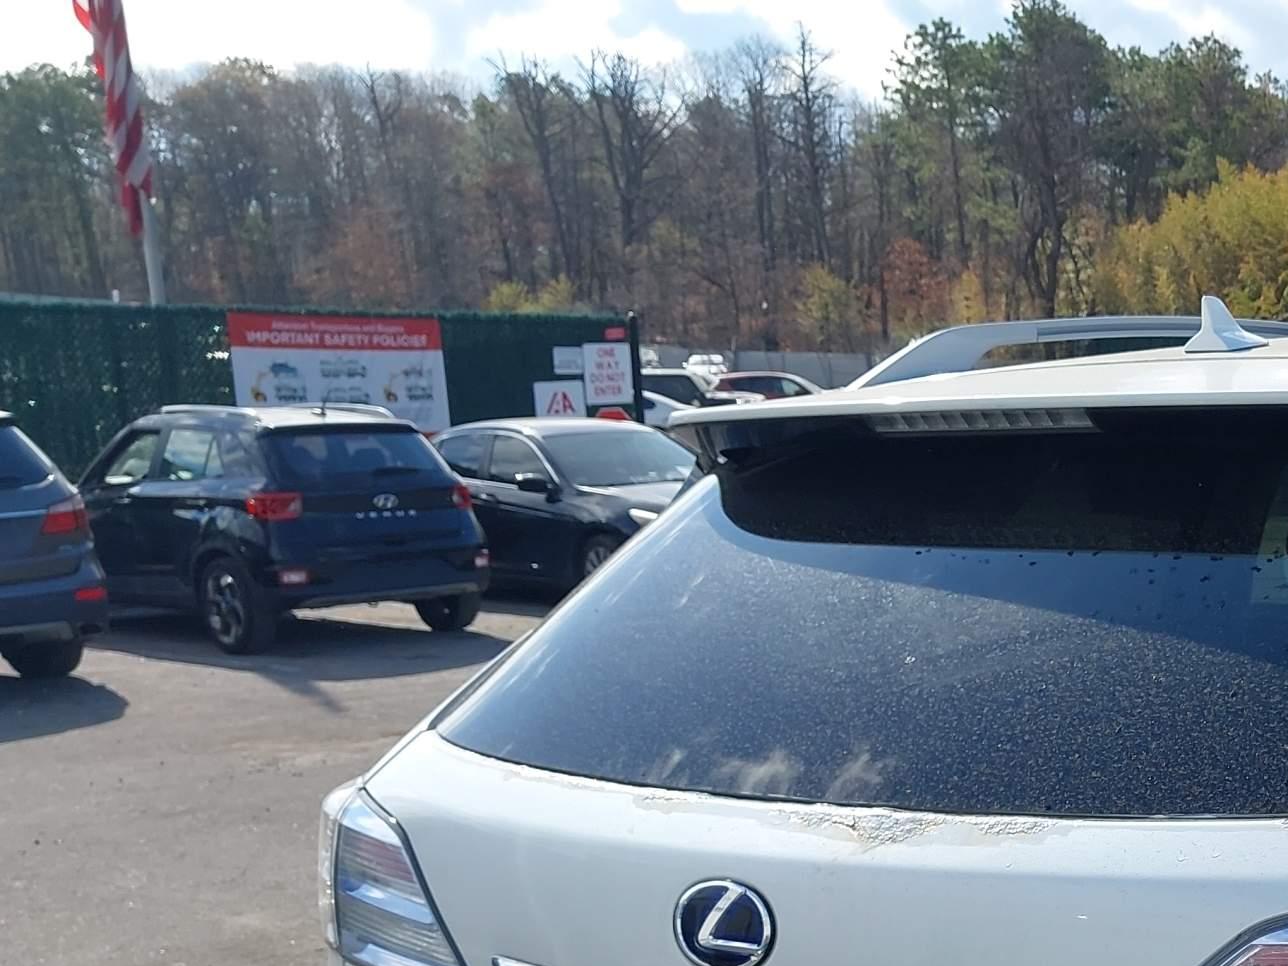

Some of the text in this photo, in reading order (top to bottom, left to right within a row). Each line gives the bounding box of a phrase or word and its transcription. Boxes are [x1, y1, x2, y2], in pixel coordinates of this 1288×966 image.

[245, 331, 427, 347] IMPORTANT SAFETY POLICIES
[594, 385, 622, 396] ENTER
